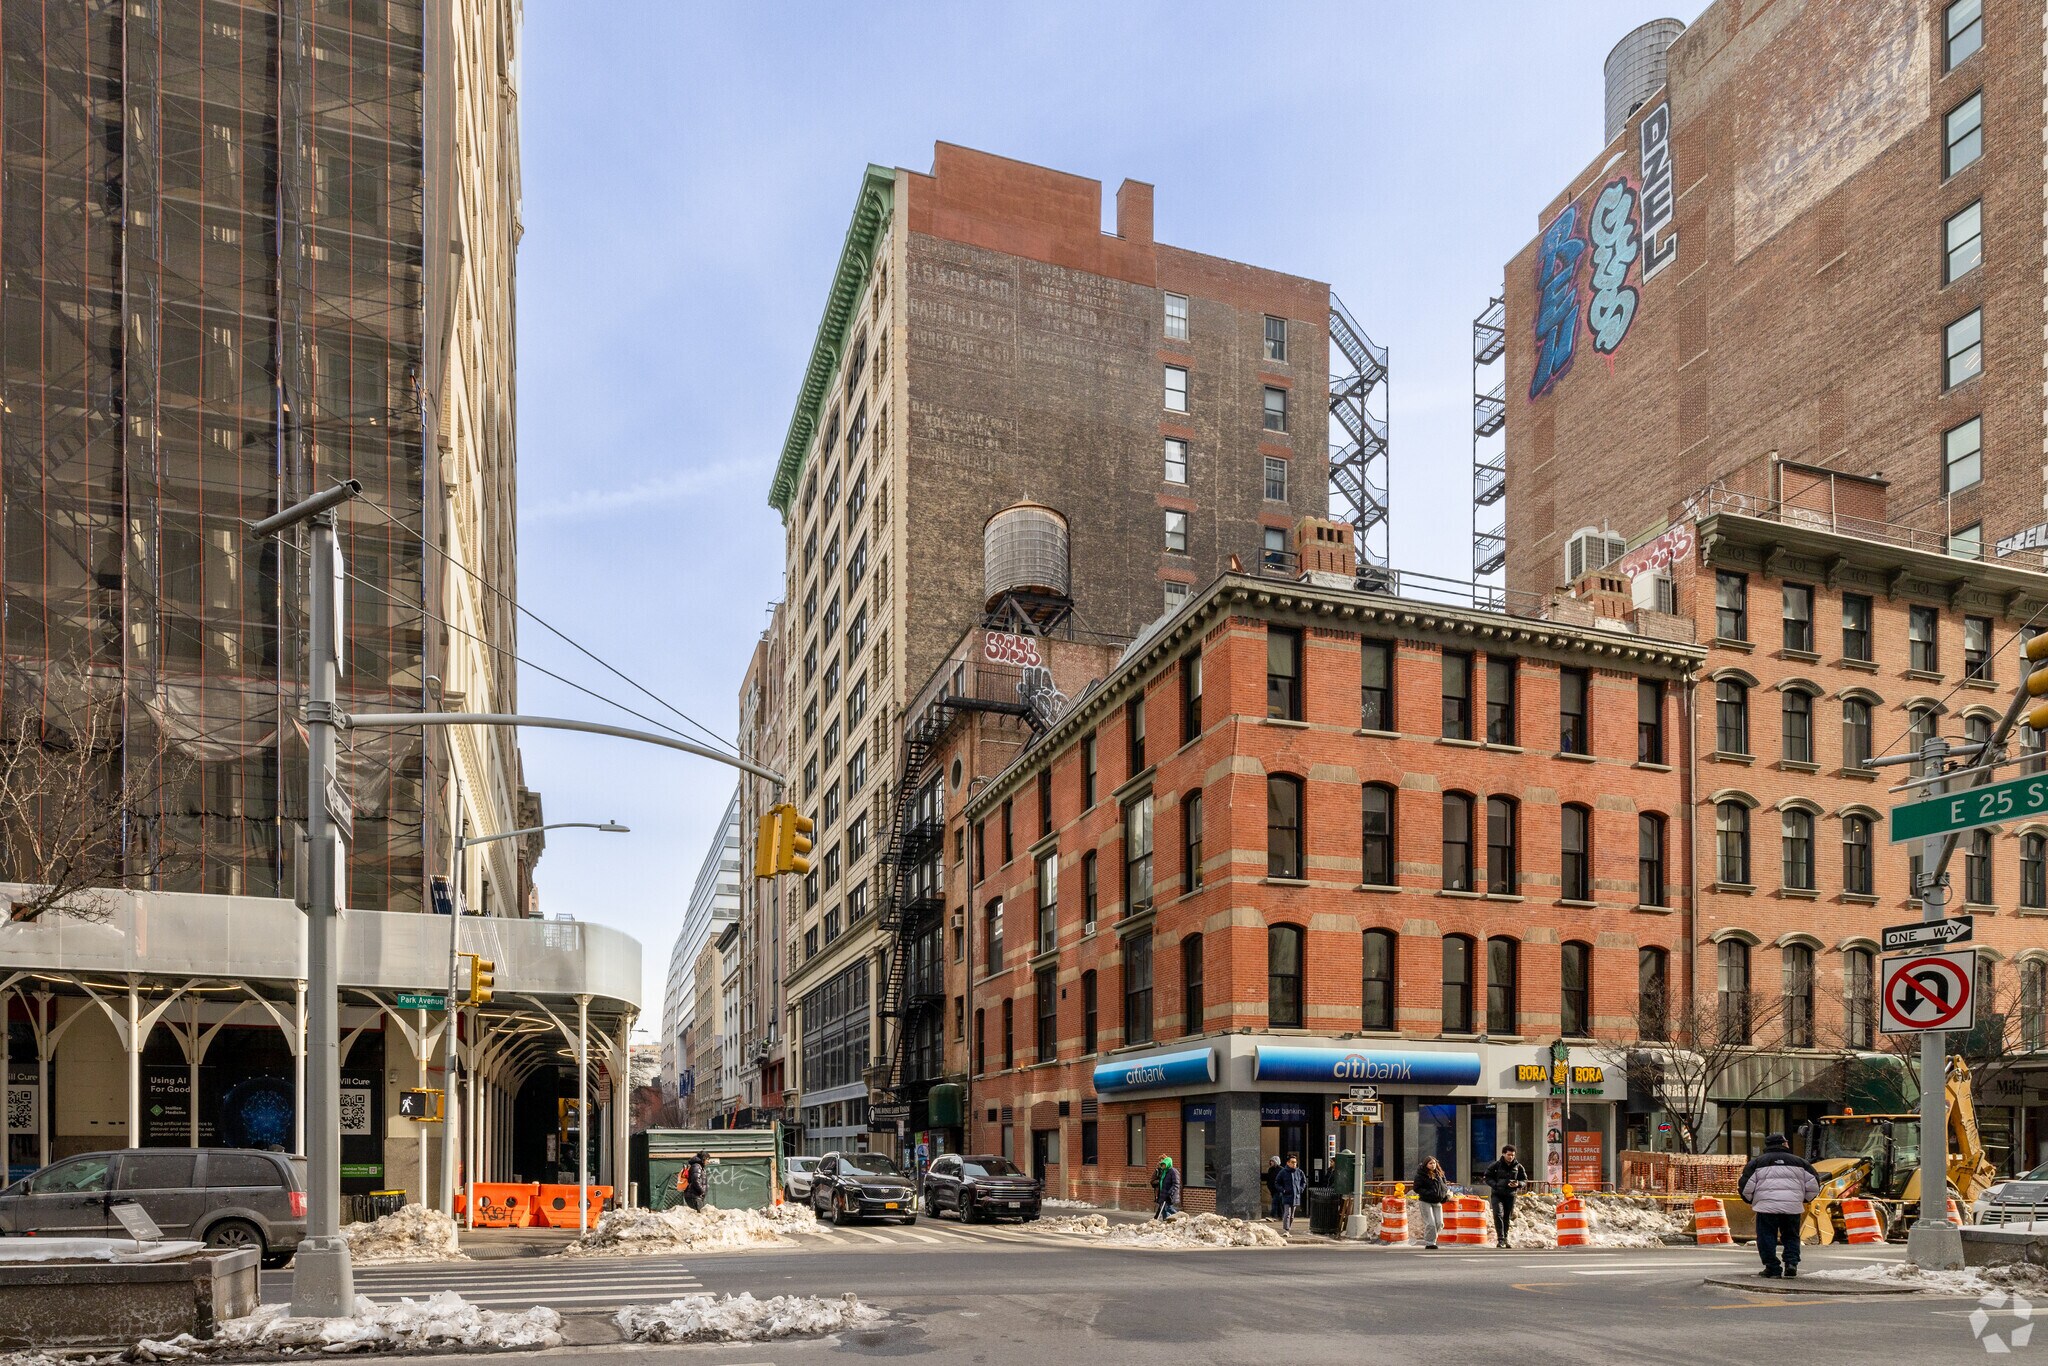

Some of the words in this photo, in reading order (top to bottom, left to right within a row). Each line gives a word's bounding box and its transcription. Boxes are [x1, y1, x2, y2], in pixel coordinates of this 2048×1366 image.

[1951, 800, 1965, 823] E
[1979, 789, 2013, 818] 25
[2027, 783, 2048, 807] S
[1889, 931, 1917, 944] ONE
[1933, 924, 1962, 938] WAY
[400, 995, 417, 1004] Park
[418, 996, 444, 1005] Avenue
[1333, 1056, 1412, 1080] citibank
[17, 1073, 38, 1081] Cure
[1126, 1064, 1166, 1084] citibank
[1517, 1065, 1548, 1082] BORA
[1574, 1066, 1604, 1083] BORA
[150, 1077, 175, 1085] Using
[352, 1078, 371, 1086] Cure
[150, 1085, 165, 1093] For
[167, 1085, 191, 1093] Good
[1193, 1108, 1203, 1116] ATM
[1203, 1108, 1213, 1117] only
[1265, 1107, 1280, 1115] hour
[1281, 1107, 1306, 1117] banking
